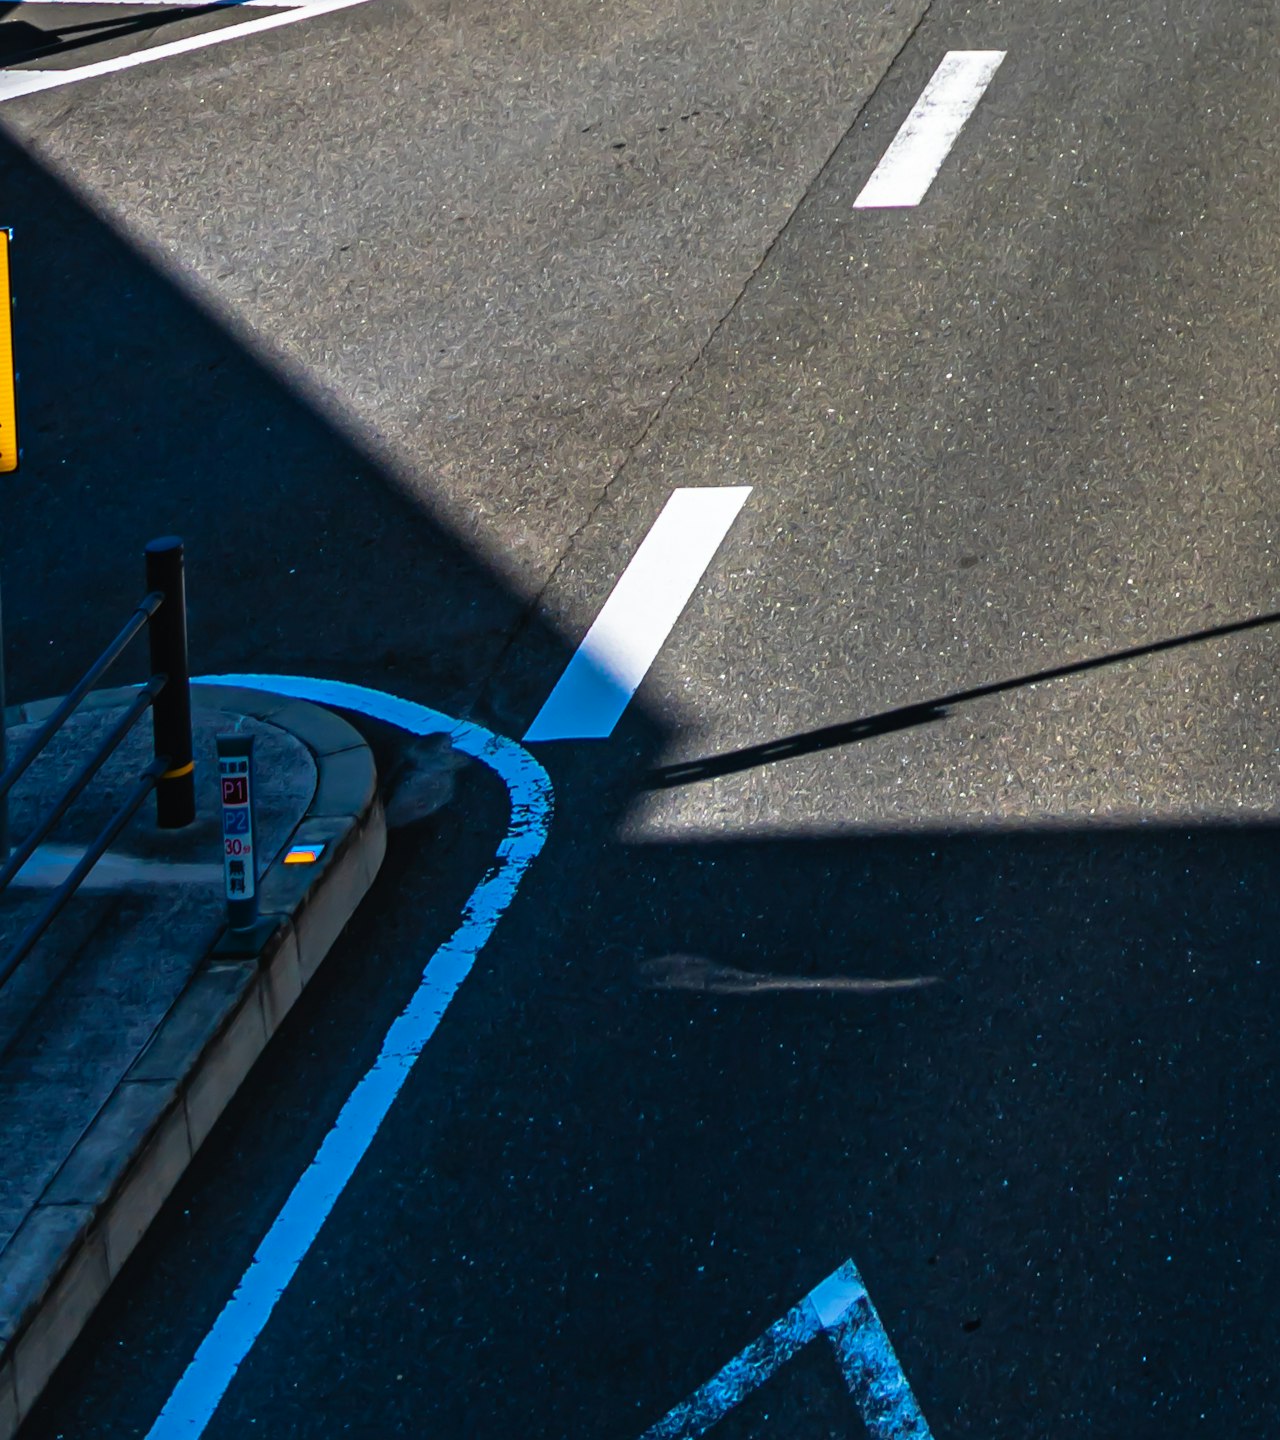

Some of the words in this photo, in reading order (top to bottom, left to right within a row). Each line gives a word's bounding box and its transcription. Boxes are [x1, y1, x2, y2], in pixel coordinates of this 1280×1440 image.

[224, 781, 243, 800] P1
[225, 812, 246, 829] P2
[224, 839, 251, 855] 30分
